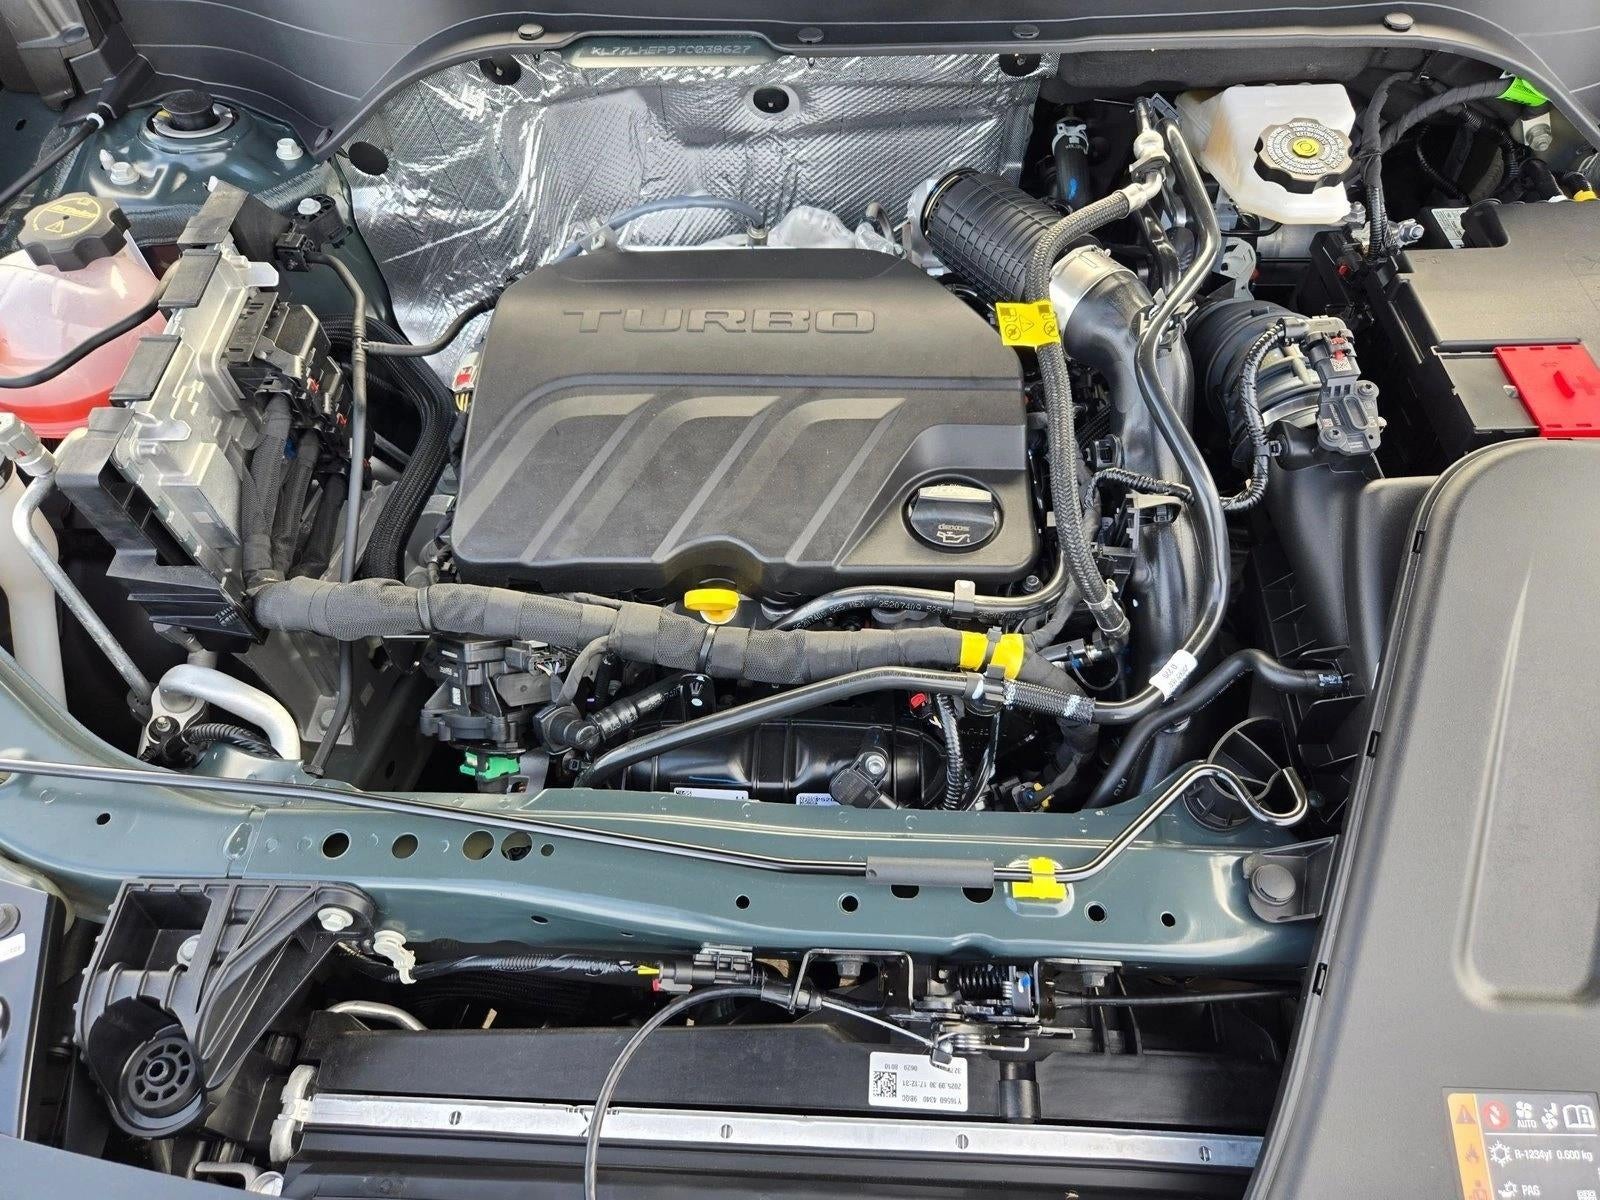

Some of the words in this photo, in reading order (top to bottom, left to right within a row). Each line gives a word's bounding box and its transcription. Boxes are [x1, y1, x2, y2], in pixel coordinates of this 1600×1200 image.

[562, 308, 876, 333] TURBO
[1516, 1119, 1538, 1128] AUTO
[1514, 1149, 1553, 1161] R-1234yf
[1556, 1149, 1580, 1161] 0.600
[1581, 1149, 1594, 1162] kg
